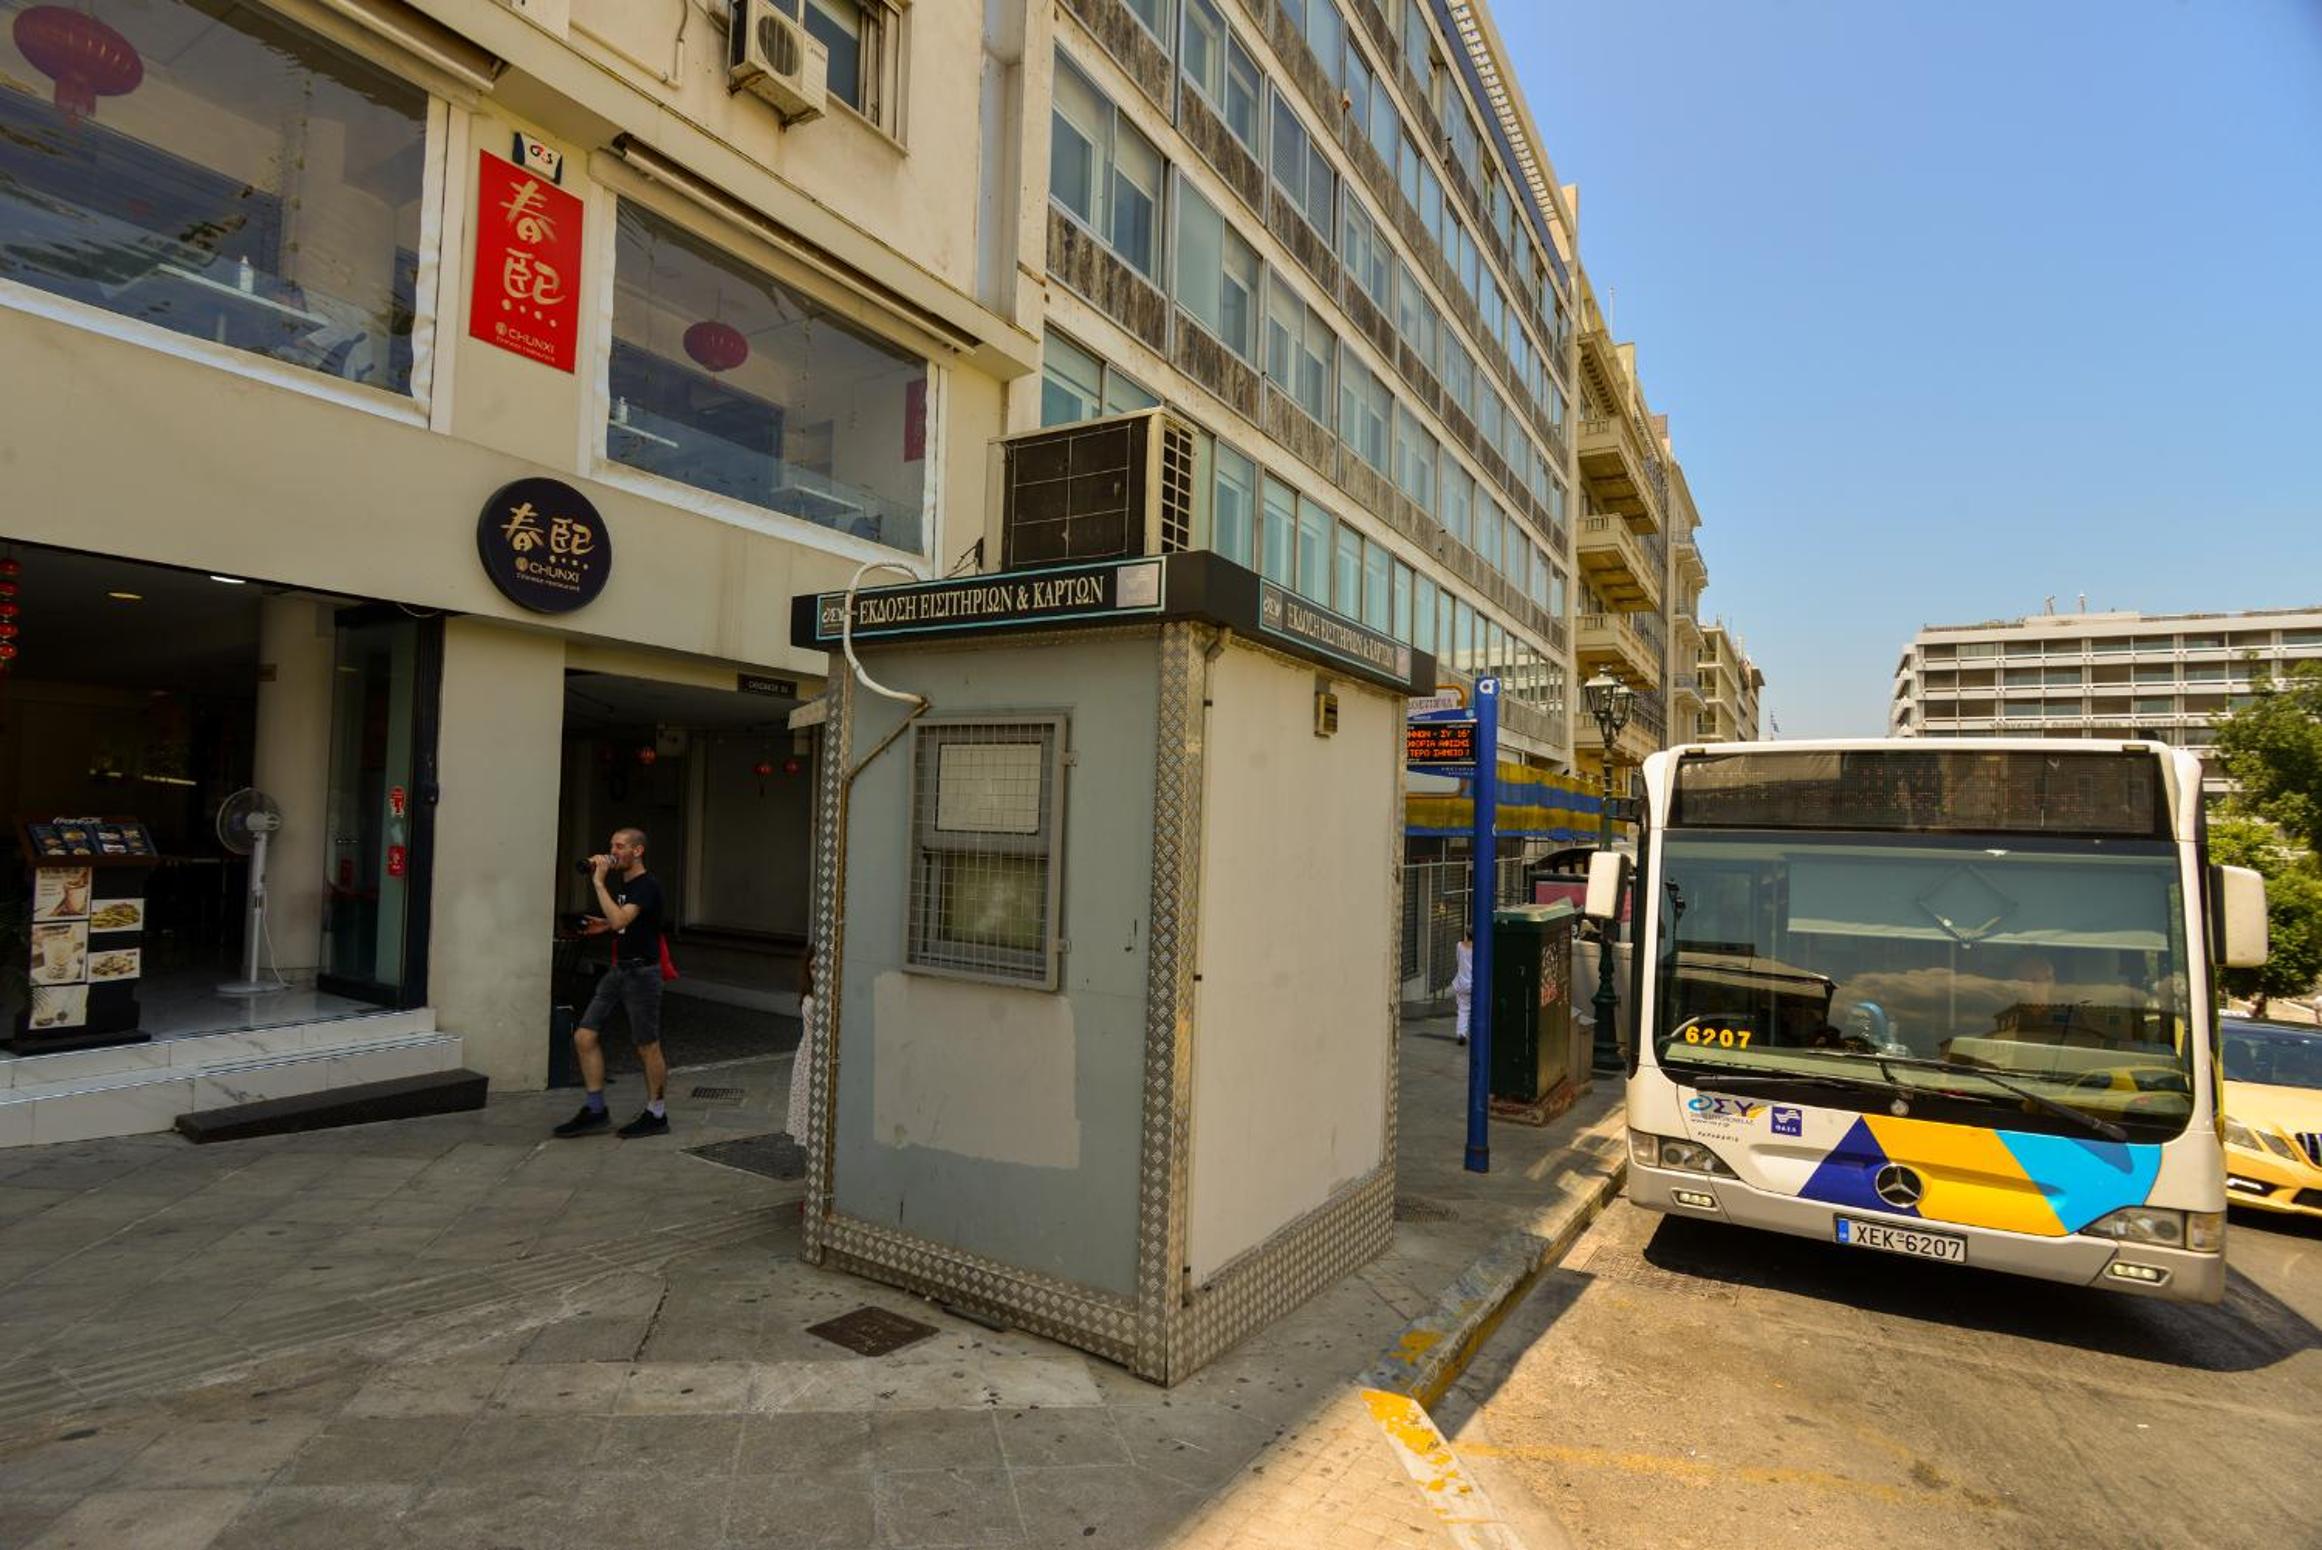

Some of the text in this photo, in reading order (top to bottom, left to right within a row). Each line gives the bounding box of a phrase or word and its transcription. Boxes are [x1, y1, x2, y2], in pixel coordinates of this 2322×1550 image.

[508, 328, 555, 354] CHUNXI
[529, 562, 581, 583] CHUNXI
[859, 575, 1104, 625] ΕΚΔΟΣΗ ΕΙΣΙΤΗΡΙΩΝ & ΚΑΡΤΩΝ
[1685, 1025, 1752, 1049] 6207
